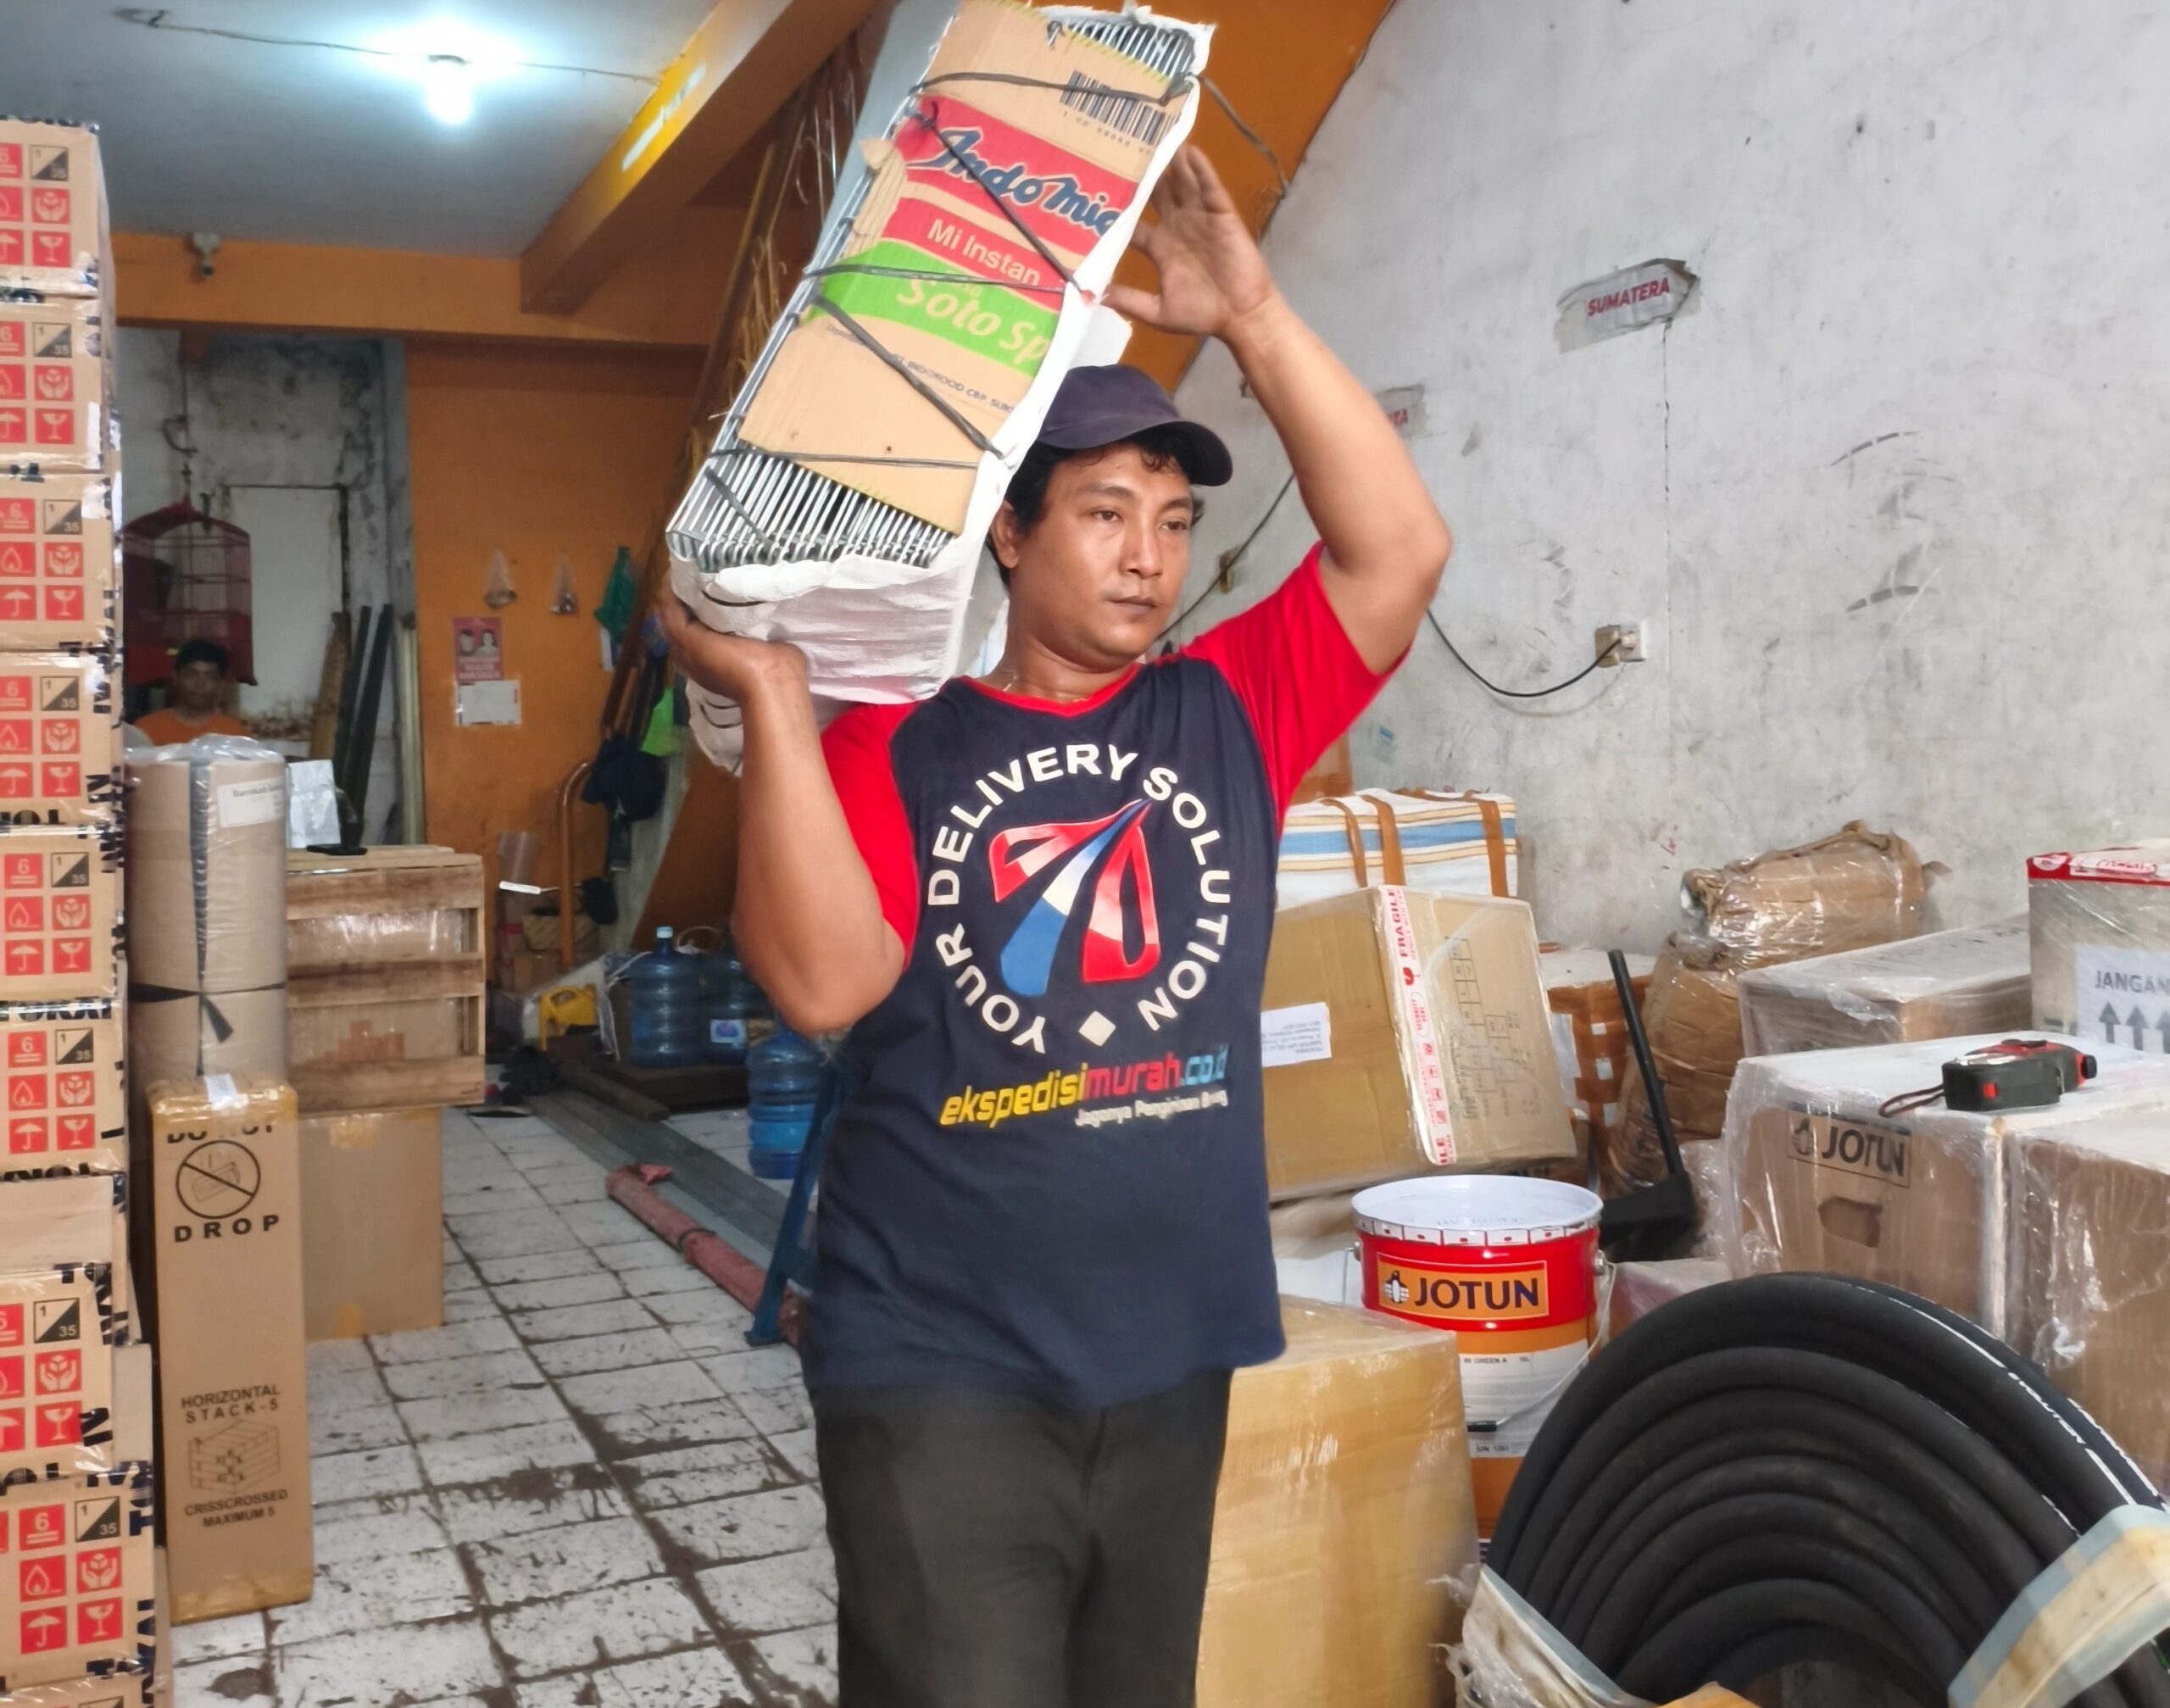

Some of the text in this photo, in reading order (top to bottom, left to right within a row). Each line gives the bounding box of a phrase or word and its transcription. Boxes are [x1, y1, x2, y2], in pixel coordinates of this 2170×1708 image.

[926, 218, 1041, 287] Mi Instan
[1586, 276, 1671, 317] SUMATERA
[896, 280, 1003, 338] Soto
[54, 345, 69, 355] 35
[64, 522, 80, 532] 35
[7, 682, 19, 697] 6
[61, 698, 76, 708] 35
[18, 859, 30, 874] 6
[71, 874, 86, 884] 35
[927, 743, 1232, 1054] YOUR DELIVERY SOLUTION
[1386, 887, 1408, 958] FRAGILE
[21, 1037, 34, 1053] 6
[75, 1050, 91, 1061] 35
[1822, 1123, 1905, 1177] JOTUN
[174, 1215, 280, 1243] DROP
[1415, 1277, 1539, 1310] JOTUN
[59, 1325, 76, 1337] 35
[181, 1384, 281, 1409] HORIZONTAL
[184, 1488, 288, 1516] CRISSCROSSED
[35, 1512, 50, 1532] 6
[203, 1508, 264, 1527] MAXIMUM
[99, 1522, 117, 1536] 35
